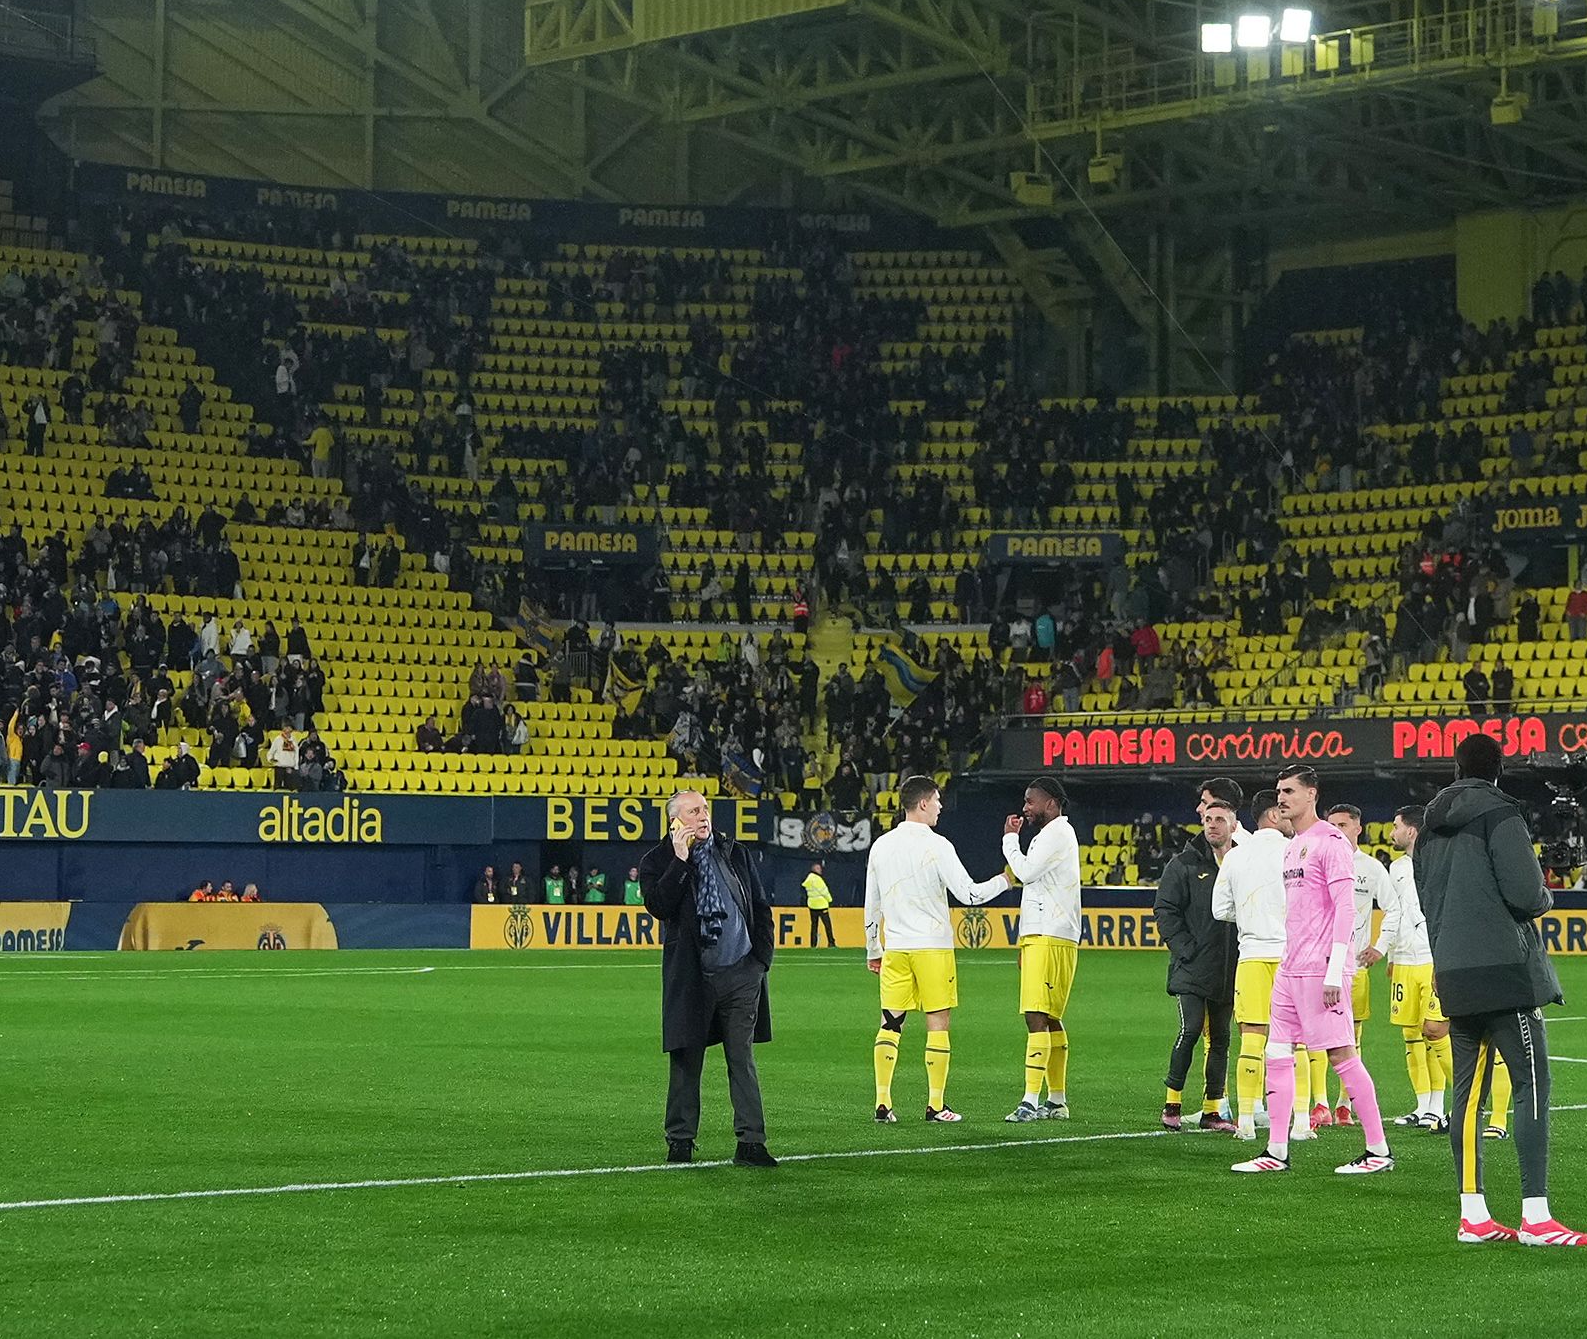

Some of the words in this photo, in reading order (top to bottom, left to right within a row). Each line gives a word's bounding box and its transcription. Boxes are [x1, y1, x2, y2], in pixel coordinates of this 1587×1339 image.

[127, 172, 207, 198] PAMESA
[618, 207, 705, 228] PAMESA
[544, 531, 637, 553] PAMESA
[1007, 537, 1102, 557] PAMESA
[1043, 727, 1176, 766] PAMESA
[1186, 725, 1355, 761] cerámica
[1393, 716, 1547, 759] PAMESA
[258, 795, 383, 843] altadia
[547, 797, 759, 841] BESTE
[1393, 982, 1403, 1002] 16
